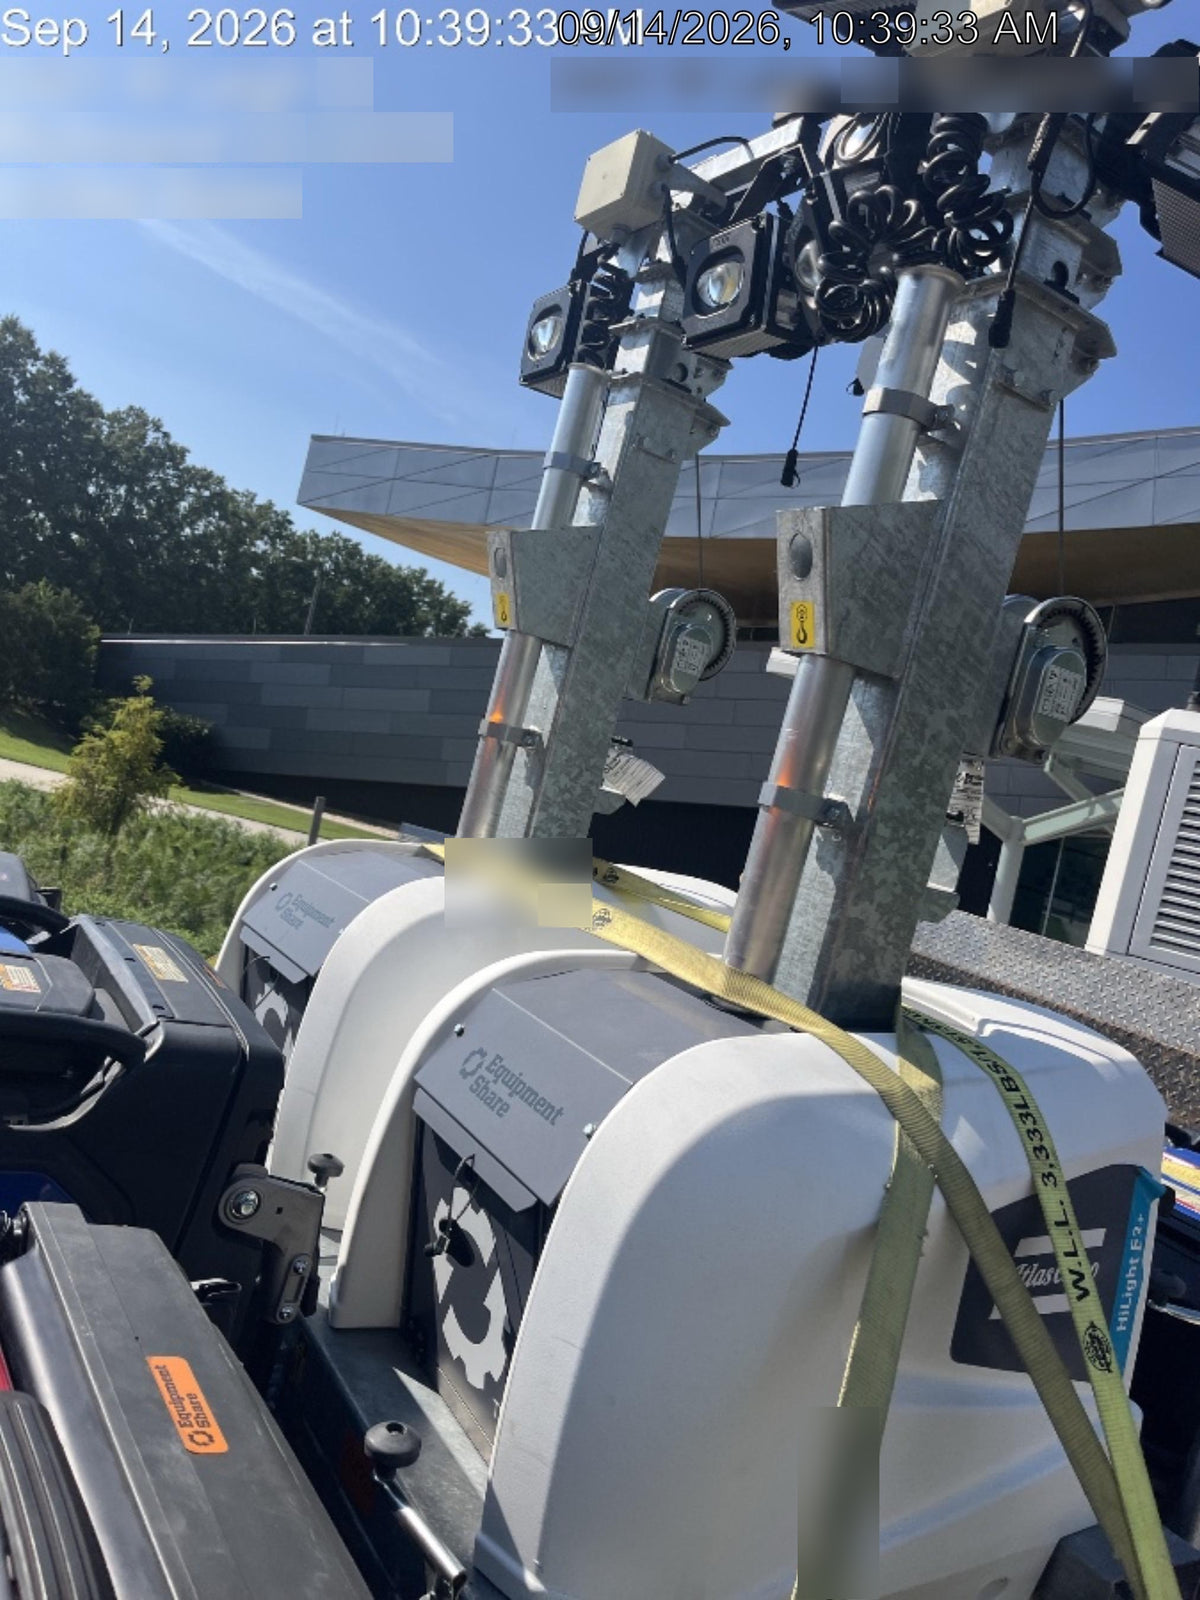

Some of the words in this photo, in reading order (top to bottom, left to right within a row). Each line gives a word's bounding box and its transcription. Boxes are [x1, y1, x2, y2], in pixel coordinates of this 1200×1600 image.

[468, 1074, 511, 1119] Share
[484, 1052, 565, 1127] Equipment
[1053, 1199, 1091, 1302] W.L.L.
[1116, 1256, 1140, 1332] HiLight
[154, 1364, 195, 1429] Equipment
[186, 1392, 211, 1429] Share
